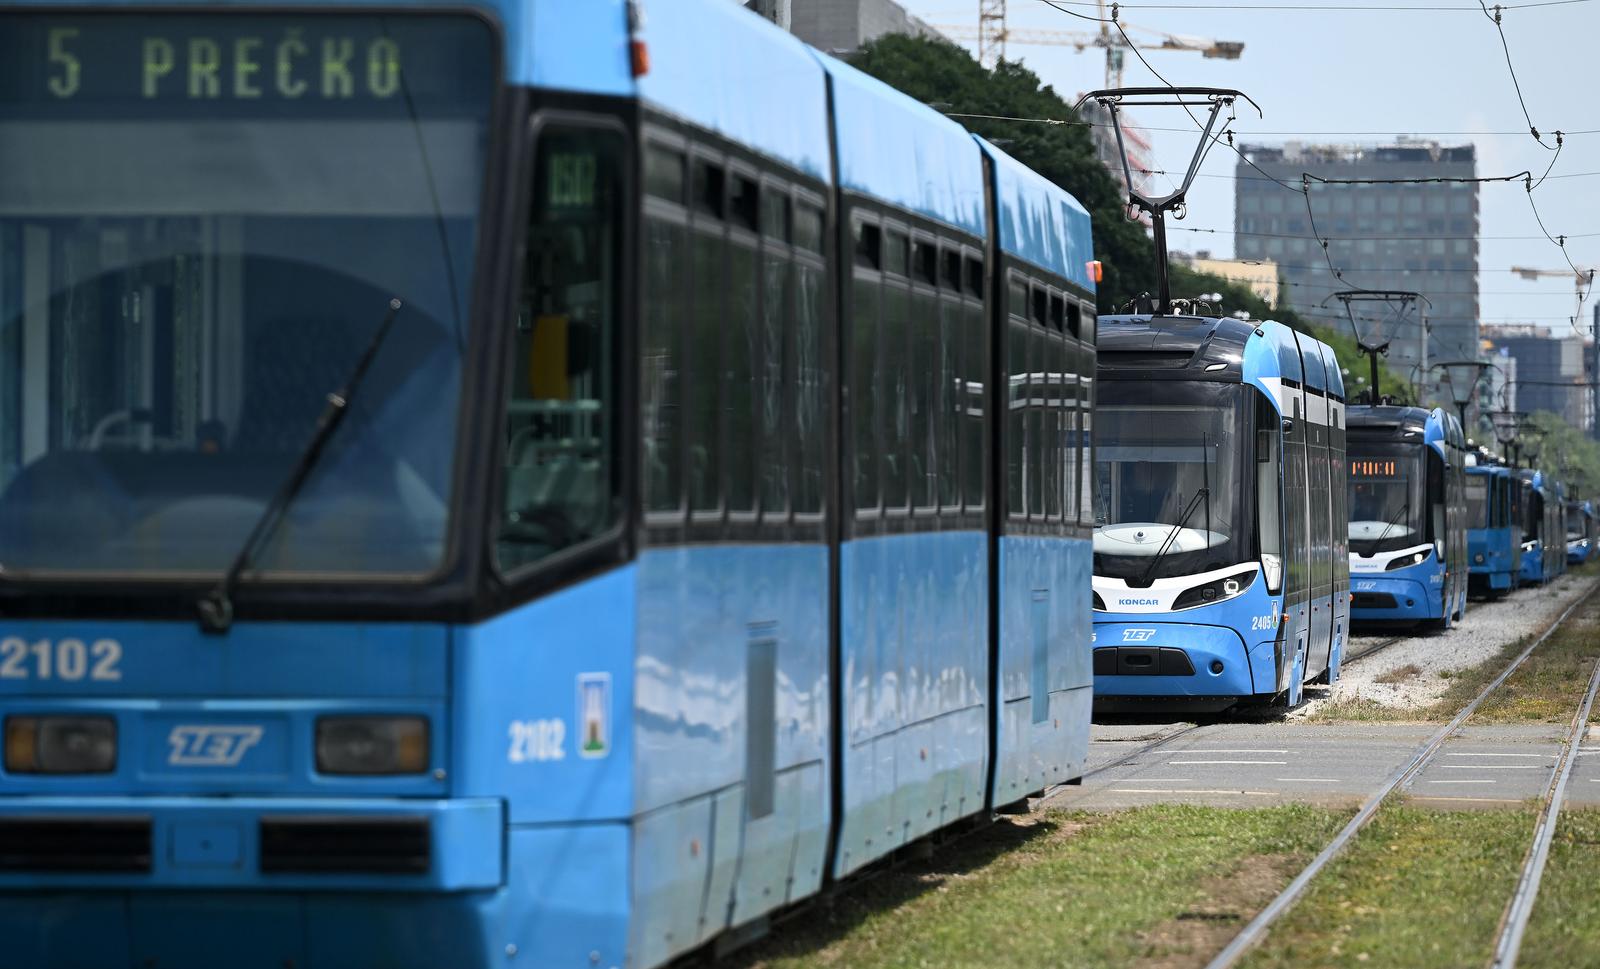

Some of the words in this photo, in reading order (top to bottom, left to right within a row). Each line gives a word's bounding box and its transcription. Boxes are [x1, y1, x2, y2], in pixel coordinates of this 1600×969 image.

[48, 28, 81, 98] 5
[141, 26, 401, 98] PREČKO
[1122, 628, 1157, 641] ZET
[1251, 615, 1272, 631] 2405
[0, 636, 122, 680] 2102
[168, 726, 264, 765] ZET
